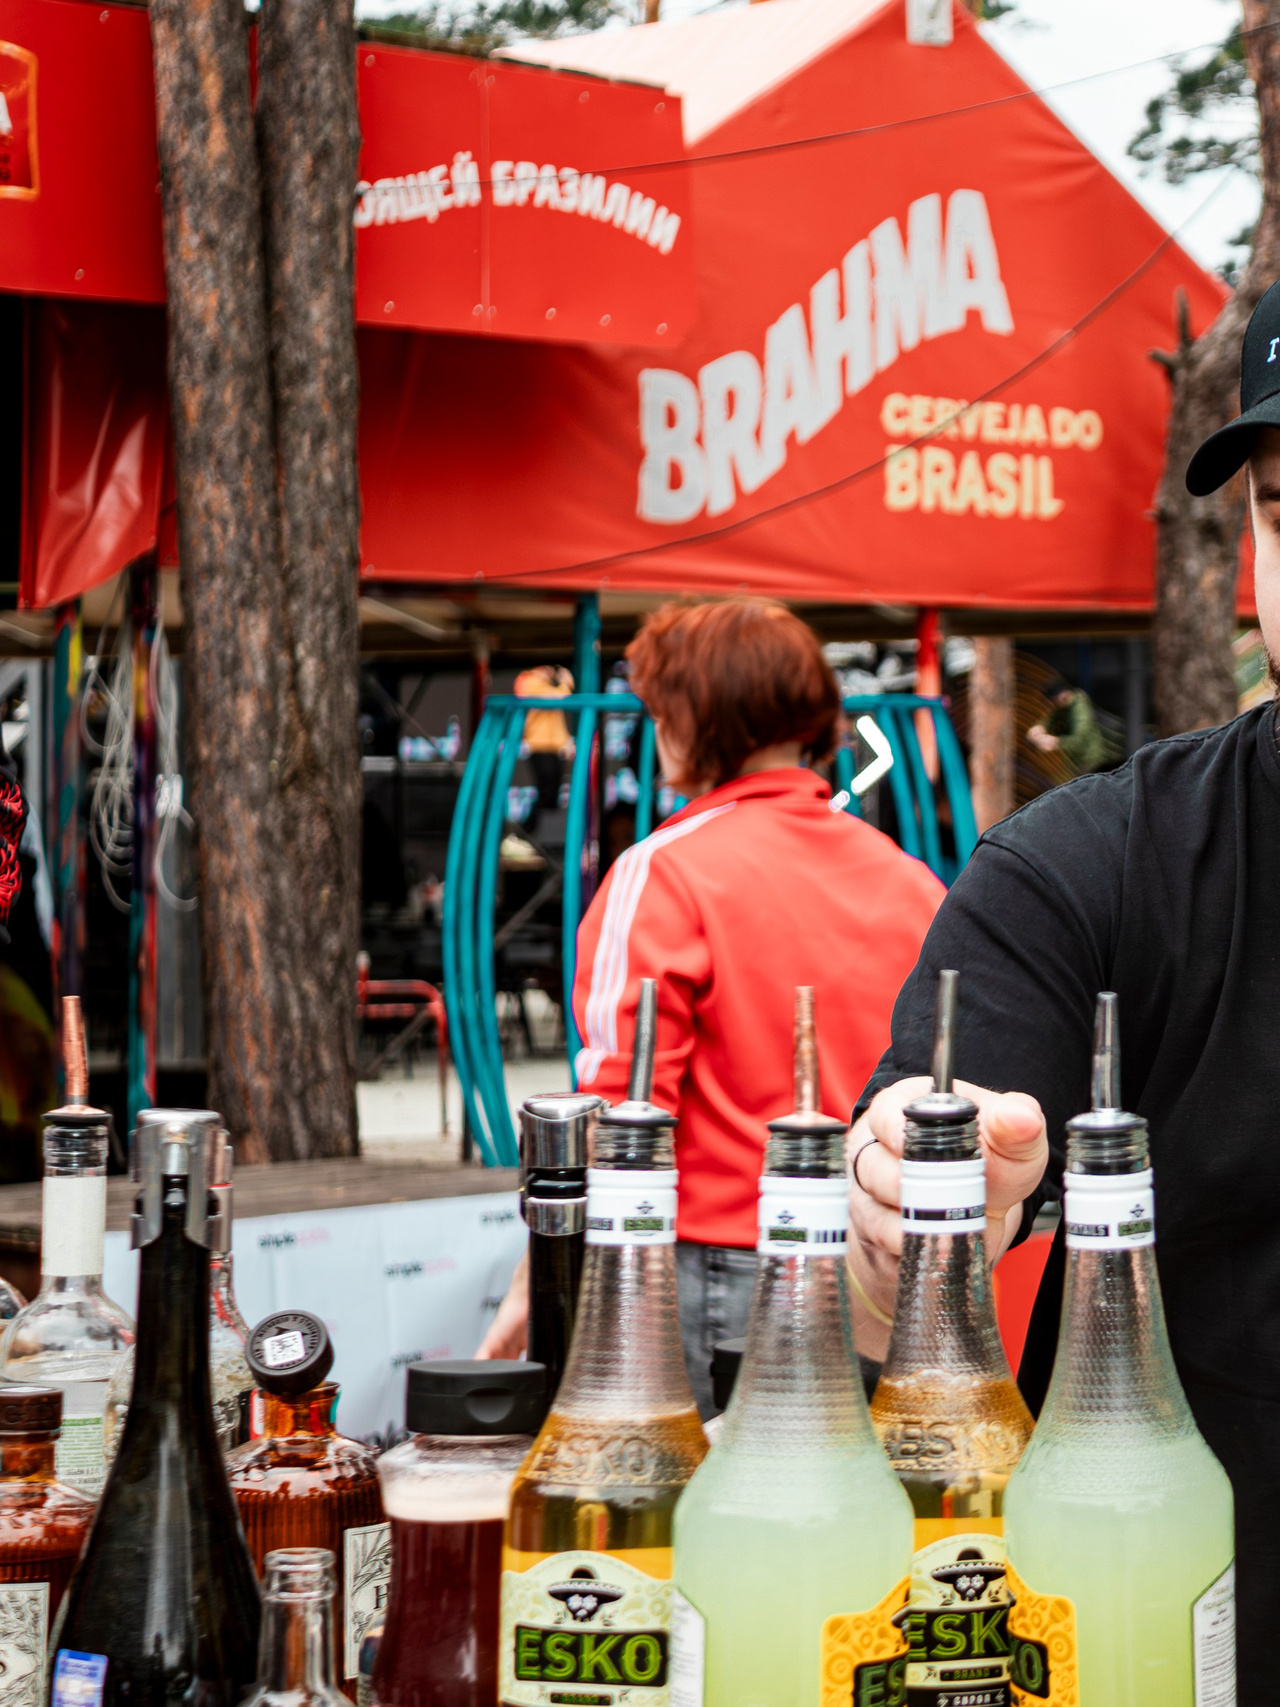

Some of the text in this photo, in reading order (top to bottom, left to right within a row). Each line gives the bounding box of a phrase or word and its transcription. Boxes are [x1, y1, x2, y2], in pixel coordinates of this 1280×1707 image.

[491, 160, 681, 255] БРАЗИЛИИ
[636, 188, 1015, 525] BRAHMA
[1266, 337, 1280, 362] I
[881, 392, 1104, 450] CERVEJA DO
[885, 444, 1066, 521] BRASIL
[516, 1627, 662, 1684] ESKO
[907, 1609, 1010, 1659] ESK
